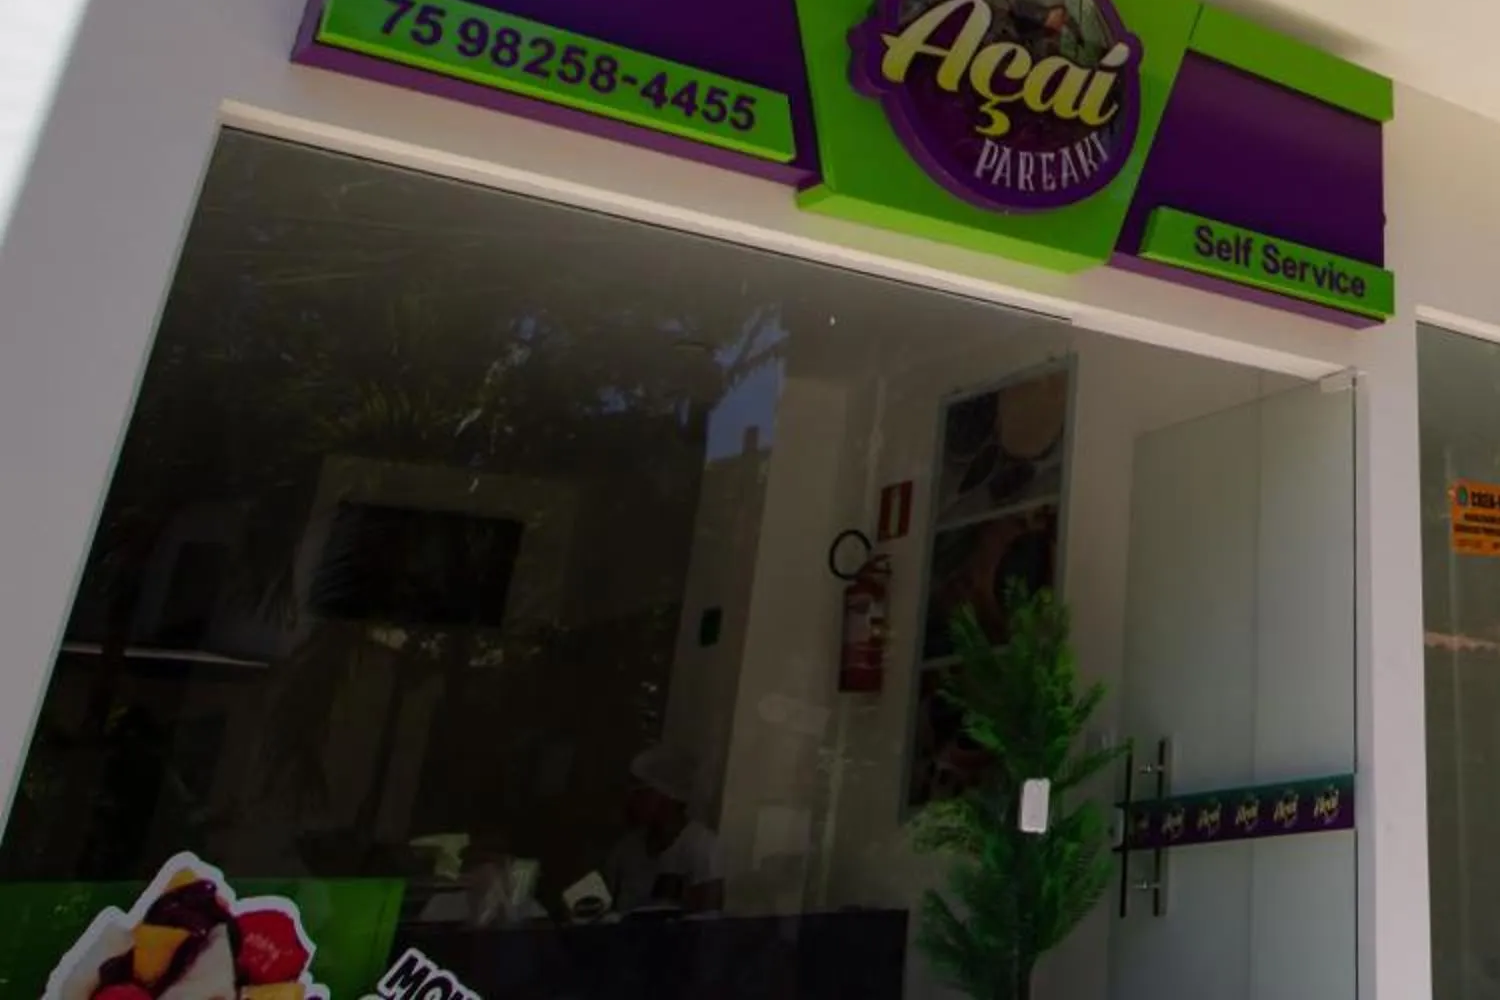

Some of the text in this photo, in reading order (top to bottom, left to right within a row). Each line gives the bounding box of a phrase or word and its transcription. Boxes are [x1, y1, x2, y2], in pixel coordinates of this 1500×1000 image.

[456, 17, 756, 131] 98258-4455
[1195, 225, 1366, 298] Self Service
